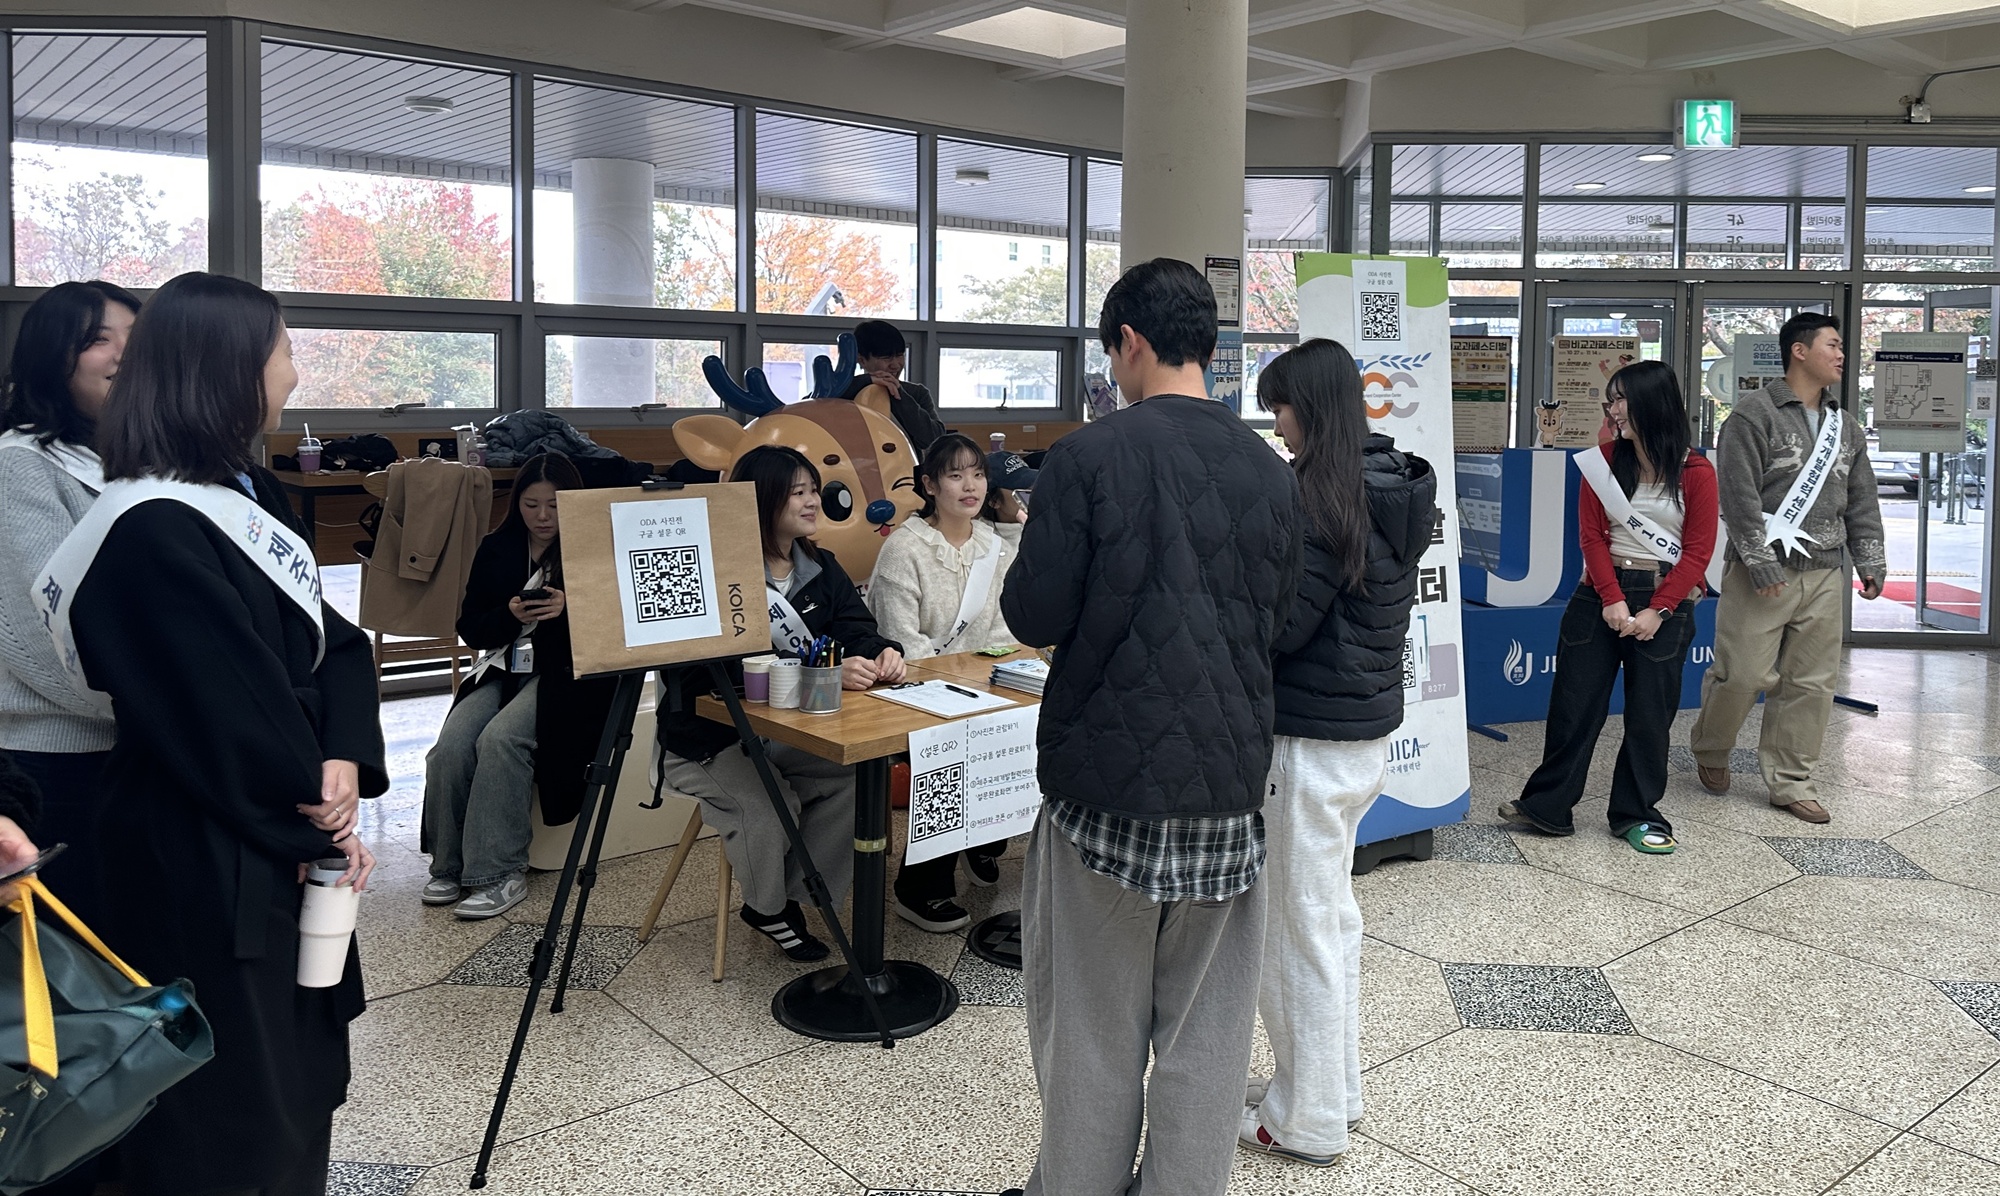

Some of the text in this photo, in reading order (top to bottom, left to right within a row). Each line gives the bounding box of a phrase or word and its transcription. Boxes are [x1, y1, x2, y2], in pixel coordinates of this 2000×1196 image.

[1571, 340, 1635, 350] 비교과페스티벌
[1753, 343, 1776, 352] 2025
[640, 516, 683, 527] ODA 사진전
[638, 527, 687, 539] 구글 설문 QR
[1627, 515, 1682, 558] 제10회
[727, 582, 747, 638] KOICA
[1428, 683, 1446, 693] 8277
[996, 722, 1019, 734] 관람하기
[1008, 744, 1031, 755] 완료하기
[1386, 760, 1421, 776] 국제협력단
